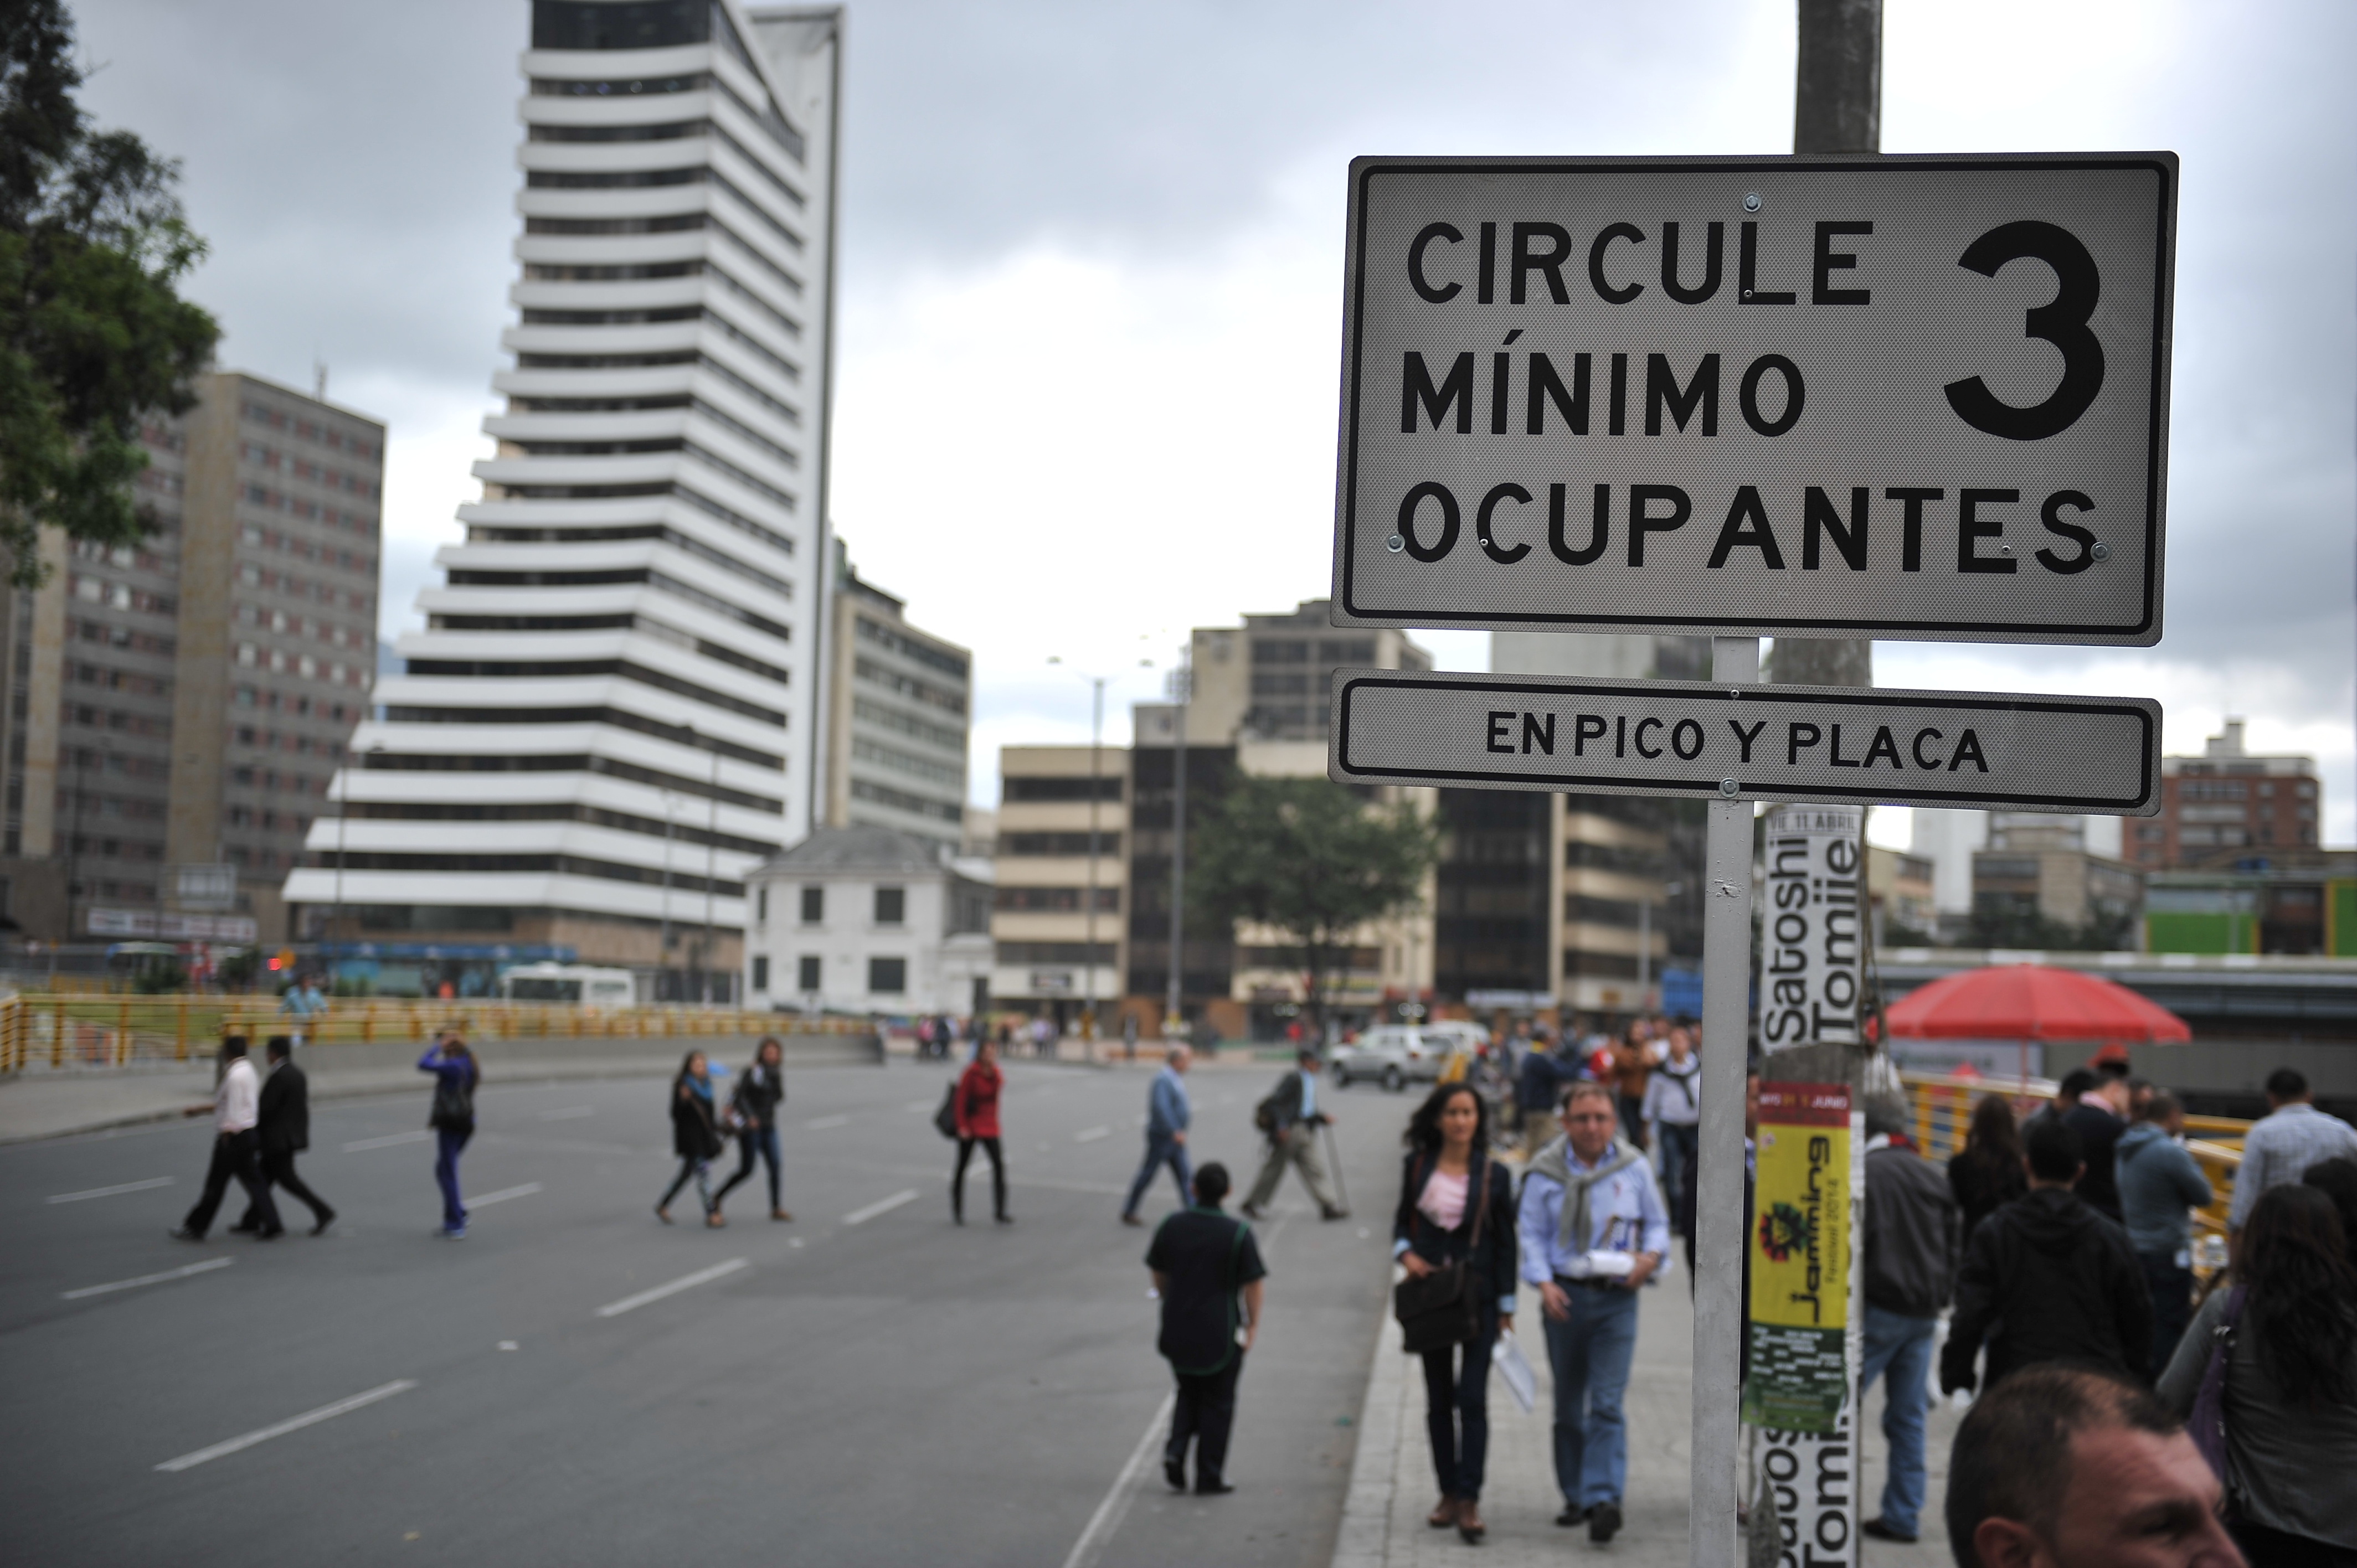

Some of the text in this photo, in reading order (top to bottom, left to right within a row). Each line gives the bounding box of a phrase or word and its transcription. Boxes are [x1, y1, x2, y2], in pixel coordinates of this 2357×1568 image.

[1407, 221, 1874, 305] CIRCULE
[1943, 219, 2106, 441] 3
[1401, 330, 1805, 437] MÍNIMO
[1397, 481, 2098, 575] OCUPANTES
[1487, 711, 1989, 773] EN PICO Y PLACA
[1815, 816, 1856, 830] ABRIL
[1765, 837, 1809, 1044] Satoshi
[1811, 838, 1858, 1041] Tomiie
